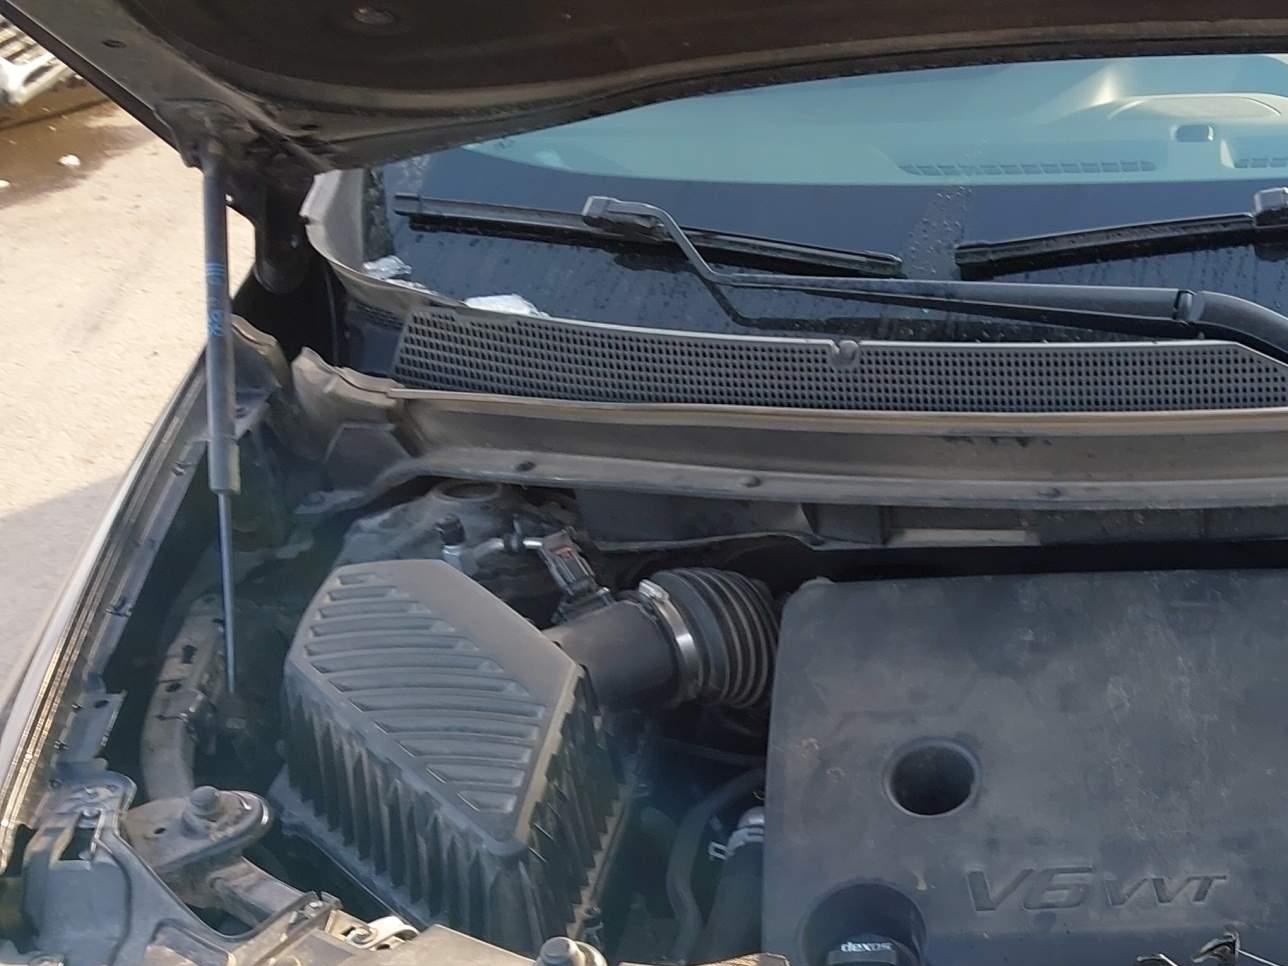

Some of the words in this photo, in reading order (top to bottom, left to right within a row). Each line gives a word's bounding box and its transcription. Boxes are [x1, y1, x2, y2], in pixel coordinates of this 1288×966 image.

[965, 865, 1096, 912] V6
[1103, 874, 1228, 906] VVT
[840, 941, 895, 953] dexos
